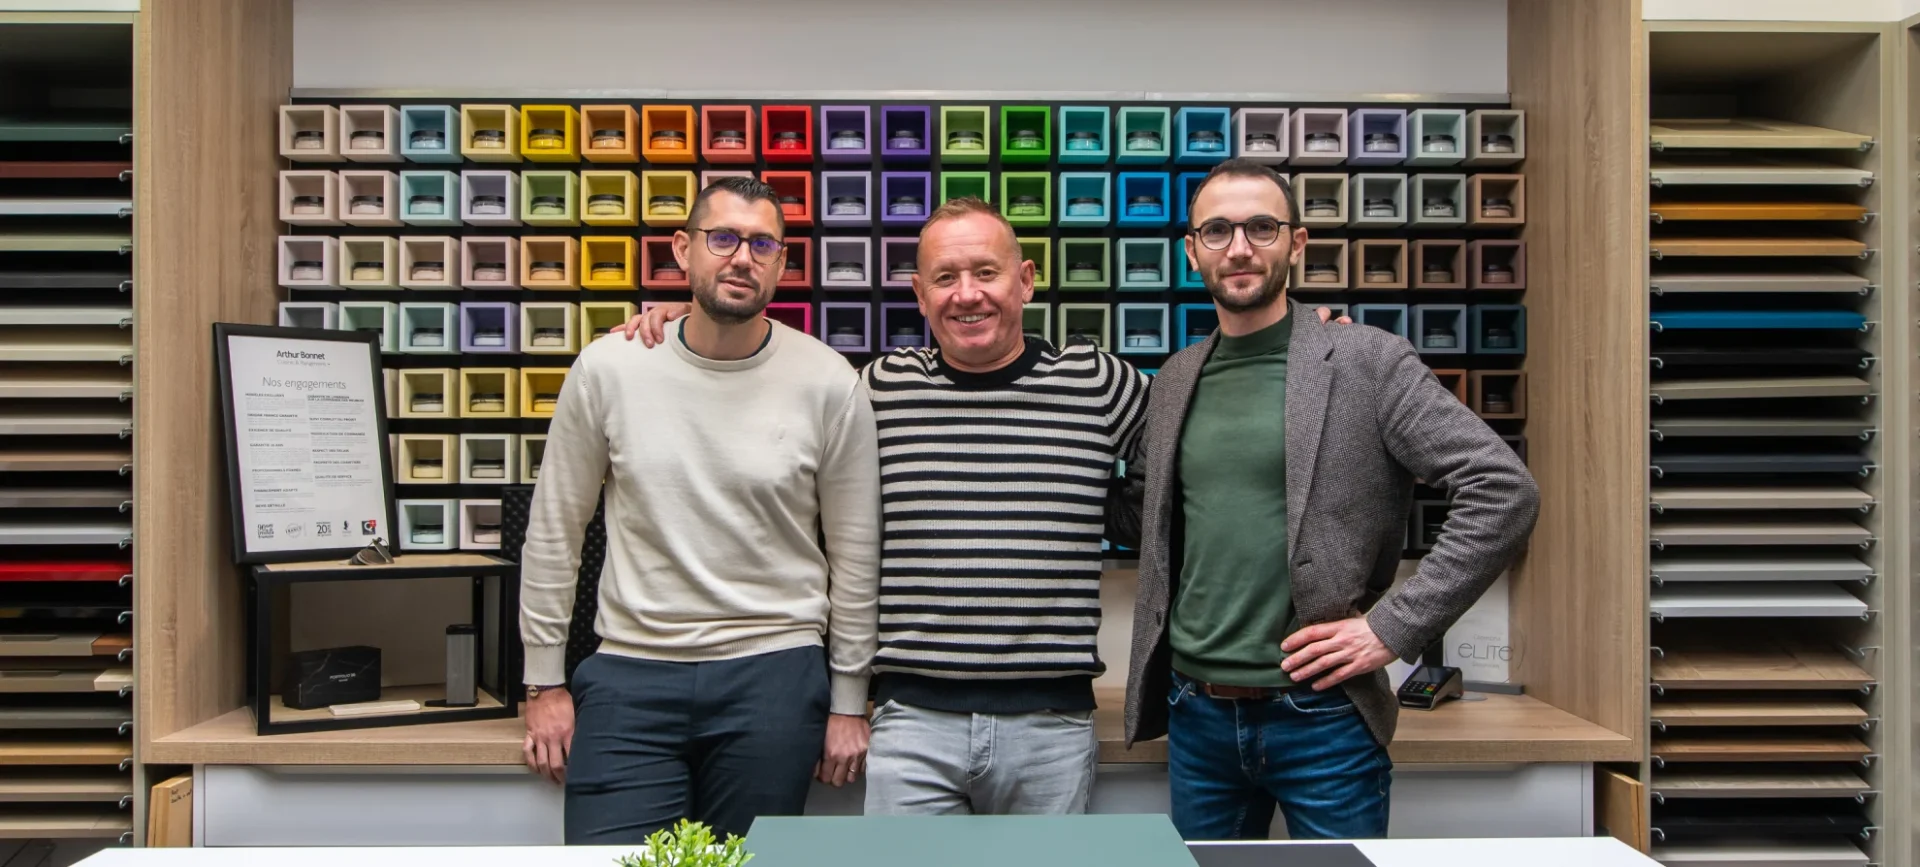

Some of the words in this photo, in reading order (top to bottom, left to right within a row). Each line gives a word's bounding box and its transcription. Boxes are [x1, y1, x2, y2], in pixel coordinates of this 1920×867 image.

[276, 350, 300, 358] Arthur
[300, 351, 326, 360] Bonnet
[262, 376, 282, 388] Nos
[284, 378, 347, 391] engagements
[316, 524, 328, 534] 20
